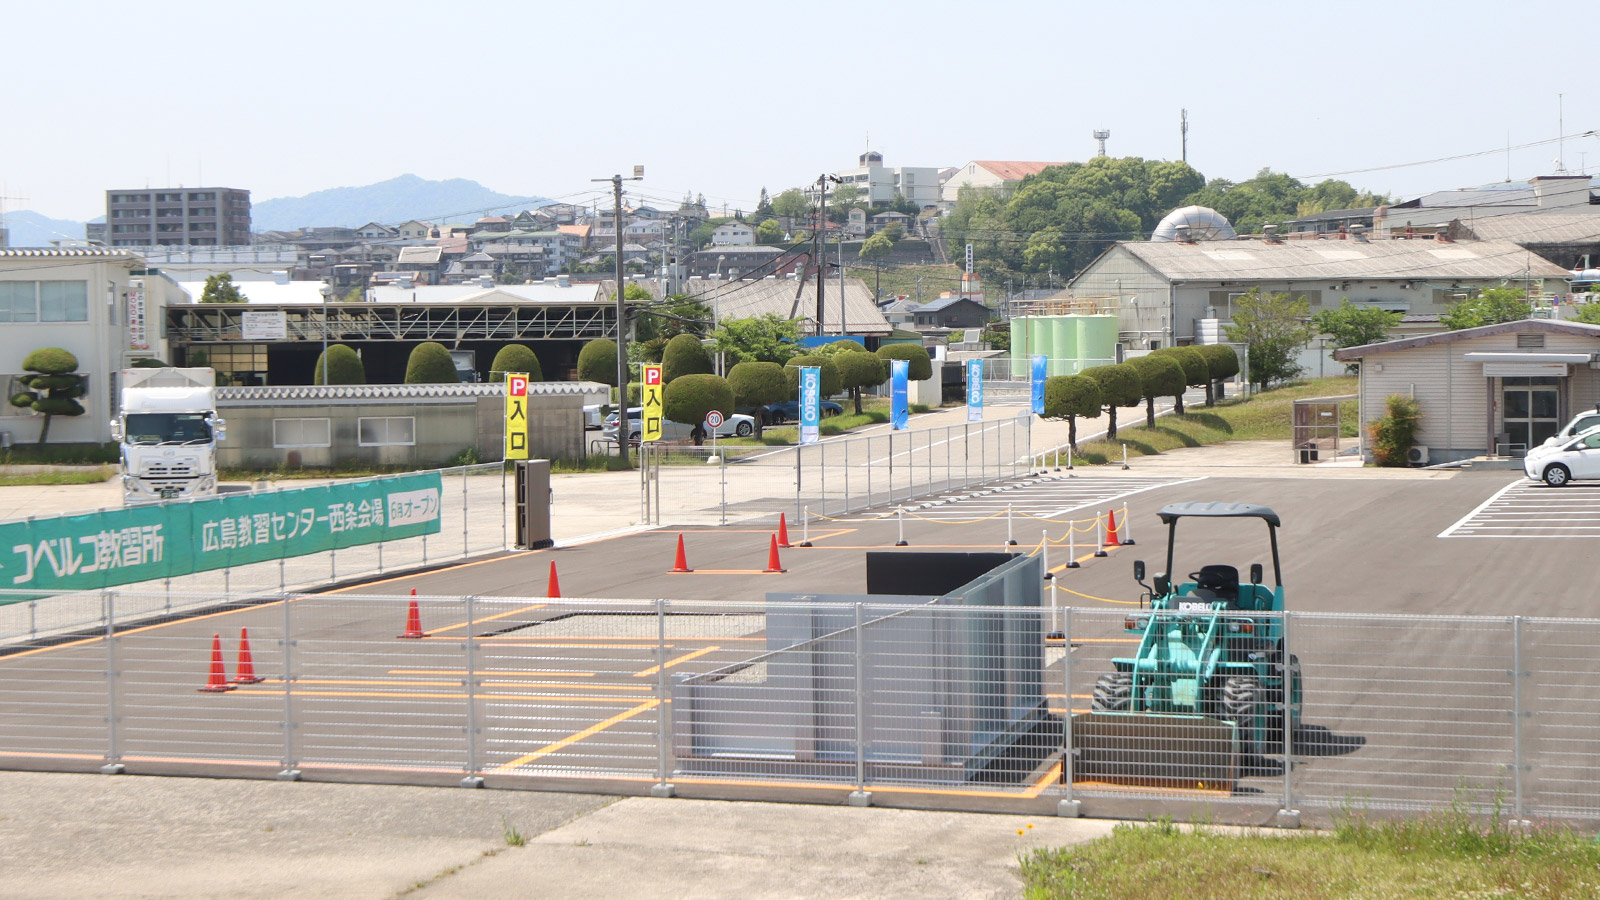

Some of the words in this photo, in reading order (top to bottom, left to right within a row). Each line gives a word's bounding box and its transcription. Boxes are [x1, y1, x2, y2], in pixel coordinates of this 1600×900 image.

[513, 379, 525, 394] P
[648, 369, 659, 384] P
[804, 373, 816, 422] KOBELCO
[971, 364, 980, 404] KOBELCO
[510, 400, 525, 450] 入口
[646, 388, 661, 434] 入口
[710, 415, 719, 423] 20
[12, 523, 165, 585] コベルコ教習所
[391, 494, 438, 520] 6月オープン
